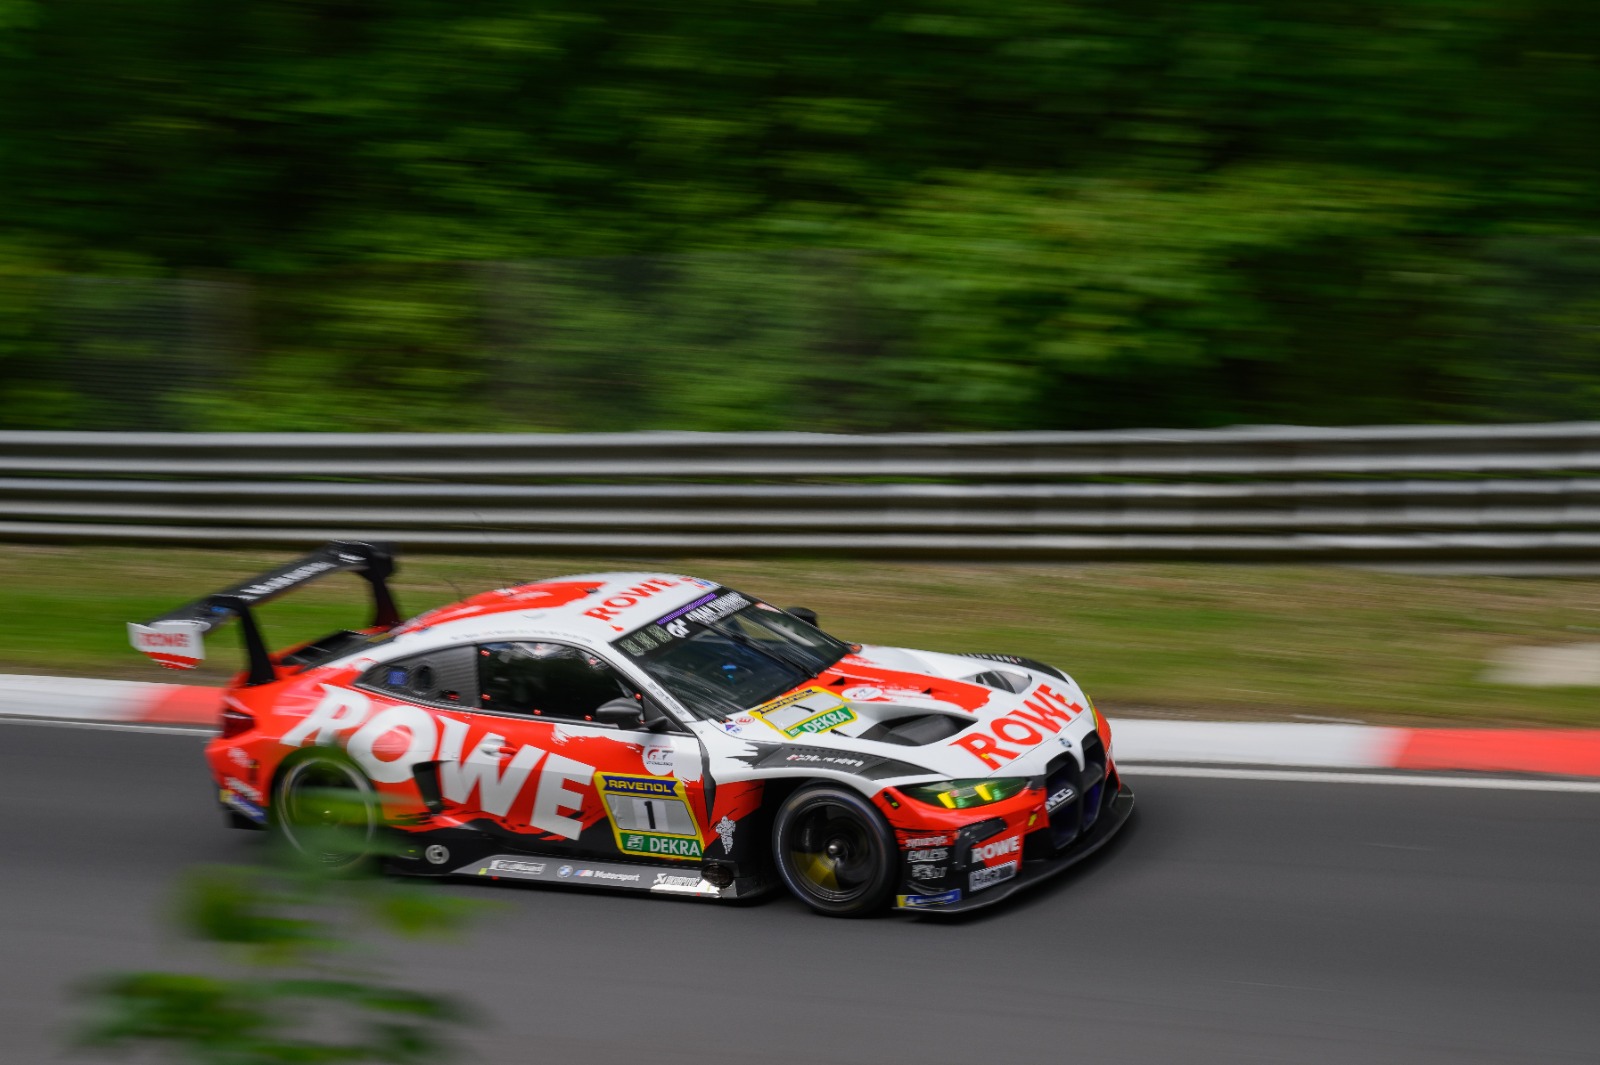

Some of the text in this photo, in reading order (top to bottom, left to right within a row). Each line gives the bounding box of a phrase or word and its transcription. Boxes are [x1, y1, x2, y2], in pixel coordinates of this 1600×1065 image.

[582, 577, 681, 622] ROWE
[802, 709, 851, 734] DEKRA
[948, 684, 1083, 771] ROWE
[279, 682, 597, 841] ROWE
[608, 779, 672, 793] RAVENOL
[644, 800, 656, 830] 1
[649, 837, 701, 857] DEKRA
[971, 835, 1020, 863] ROWE
[594, 870, 640, 882] Motorsport
